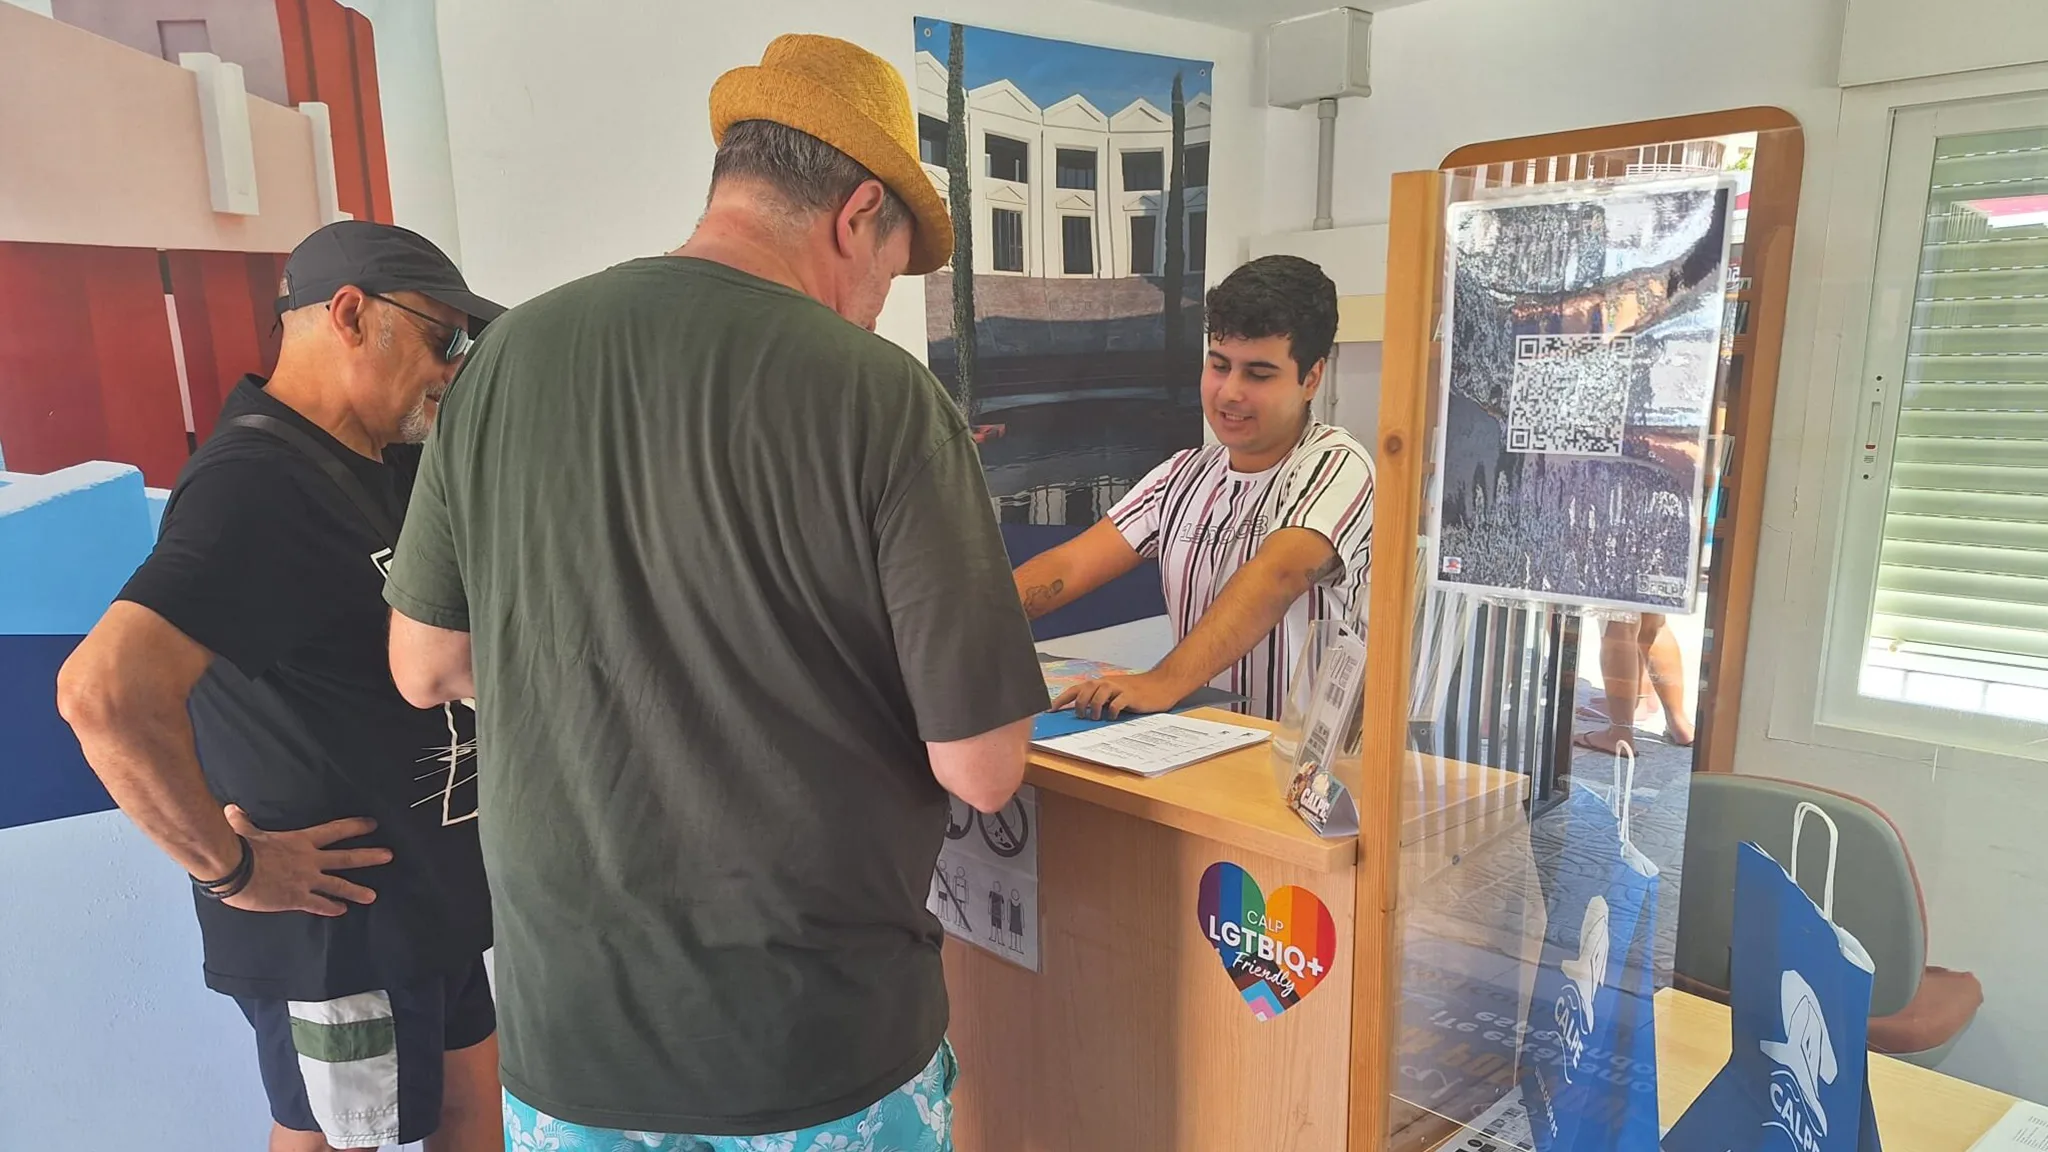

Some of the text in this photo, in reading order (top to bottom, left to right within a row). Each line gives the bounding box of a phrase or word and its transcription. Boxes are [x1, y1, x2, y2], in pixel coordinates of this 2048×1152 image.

[1209, 914, 1324, 979] LGTBIQ+
[1247, 910, 1284, 933] CALP
[1232, 951, 1295, 997] Friendly
[1555, 996, 1584, 1070] CALPE
